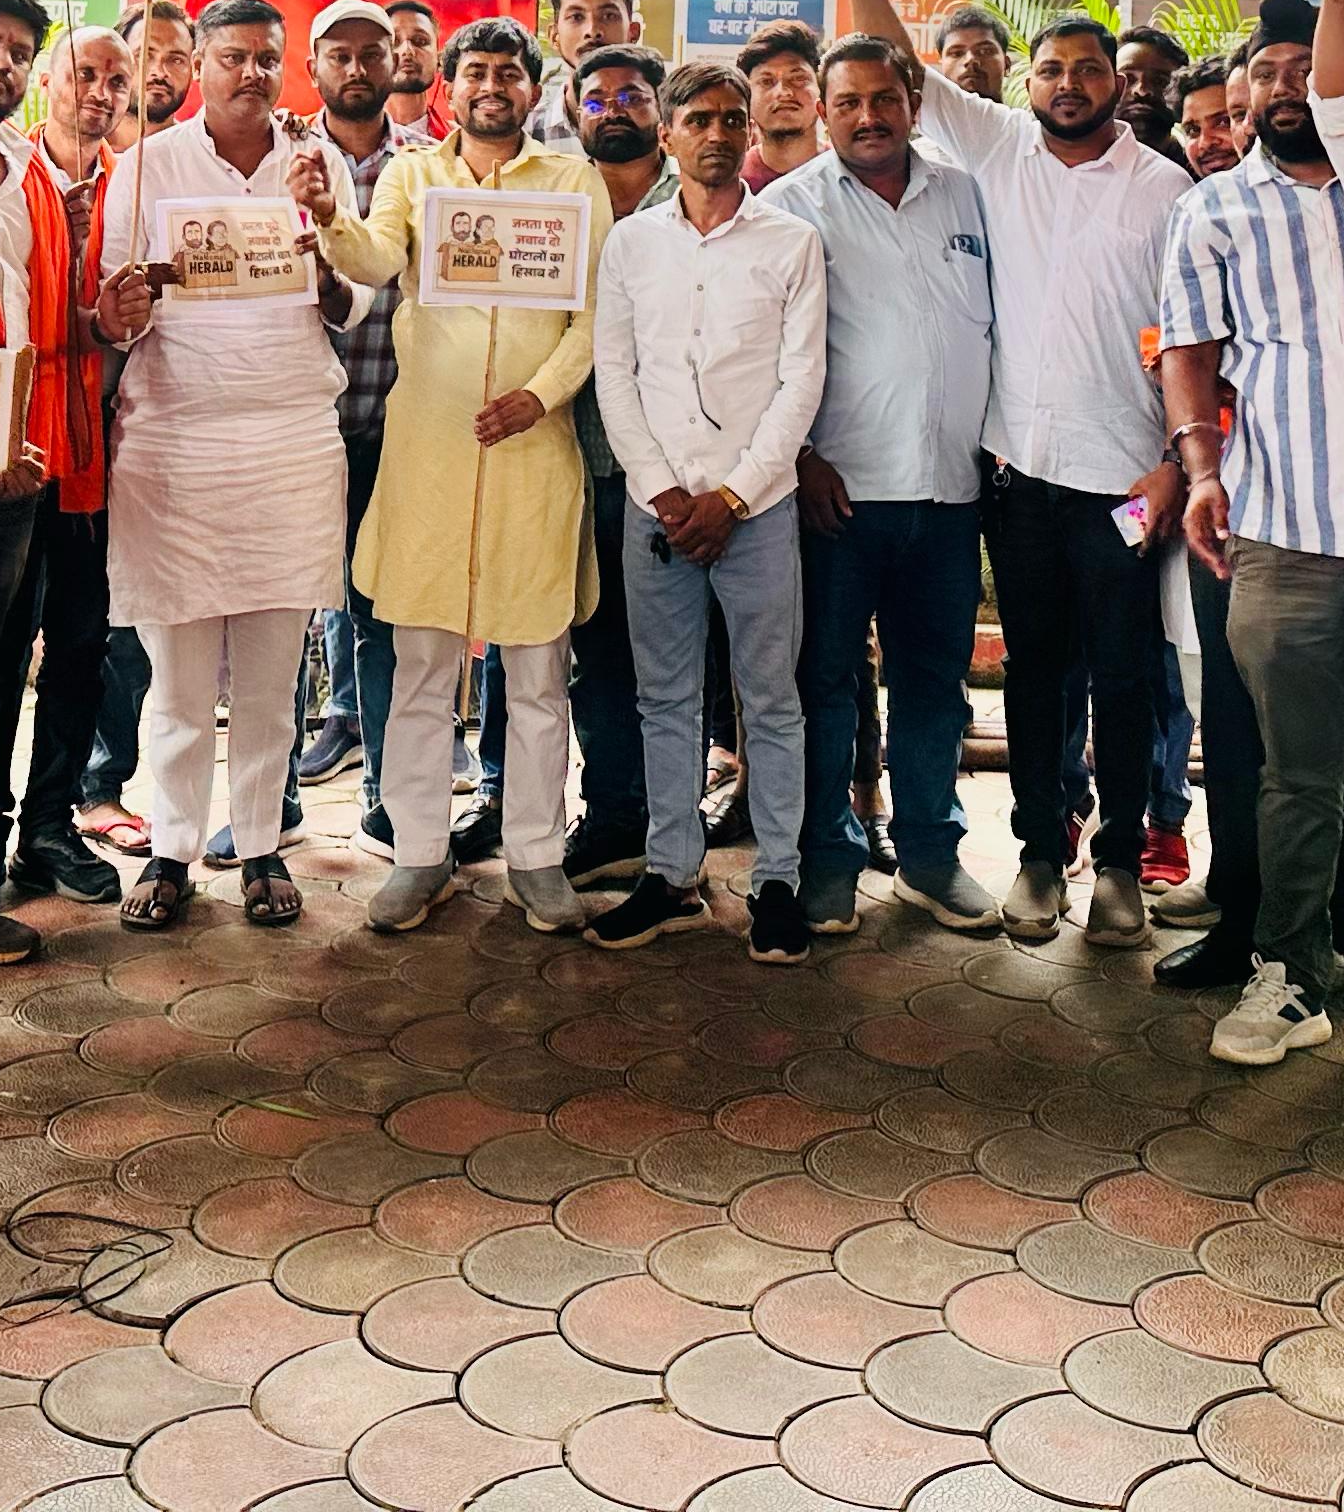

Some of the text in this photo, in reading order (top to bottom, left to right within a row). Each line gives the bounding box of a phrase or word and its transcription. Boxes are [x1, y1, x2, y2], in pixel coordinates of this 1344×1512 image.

[708, 19, 743, 36] घर-घर
[743, 16, 758, 36] में
[512, 218, 542, 230] जनता
[514, 233, 561, 247] जवाब दो
[453, 254, 497, 268] HERALD
[509, 249, 565, 263] घोटालों का
[189, 260, 234, 275] HERALD
[512, 265, 561, 279] हिसाब दो
